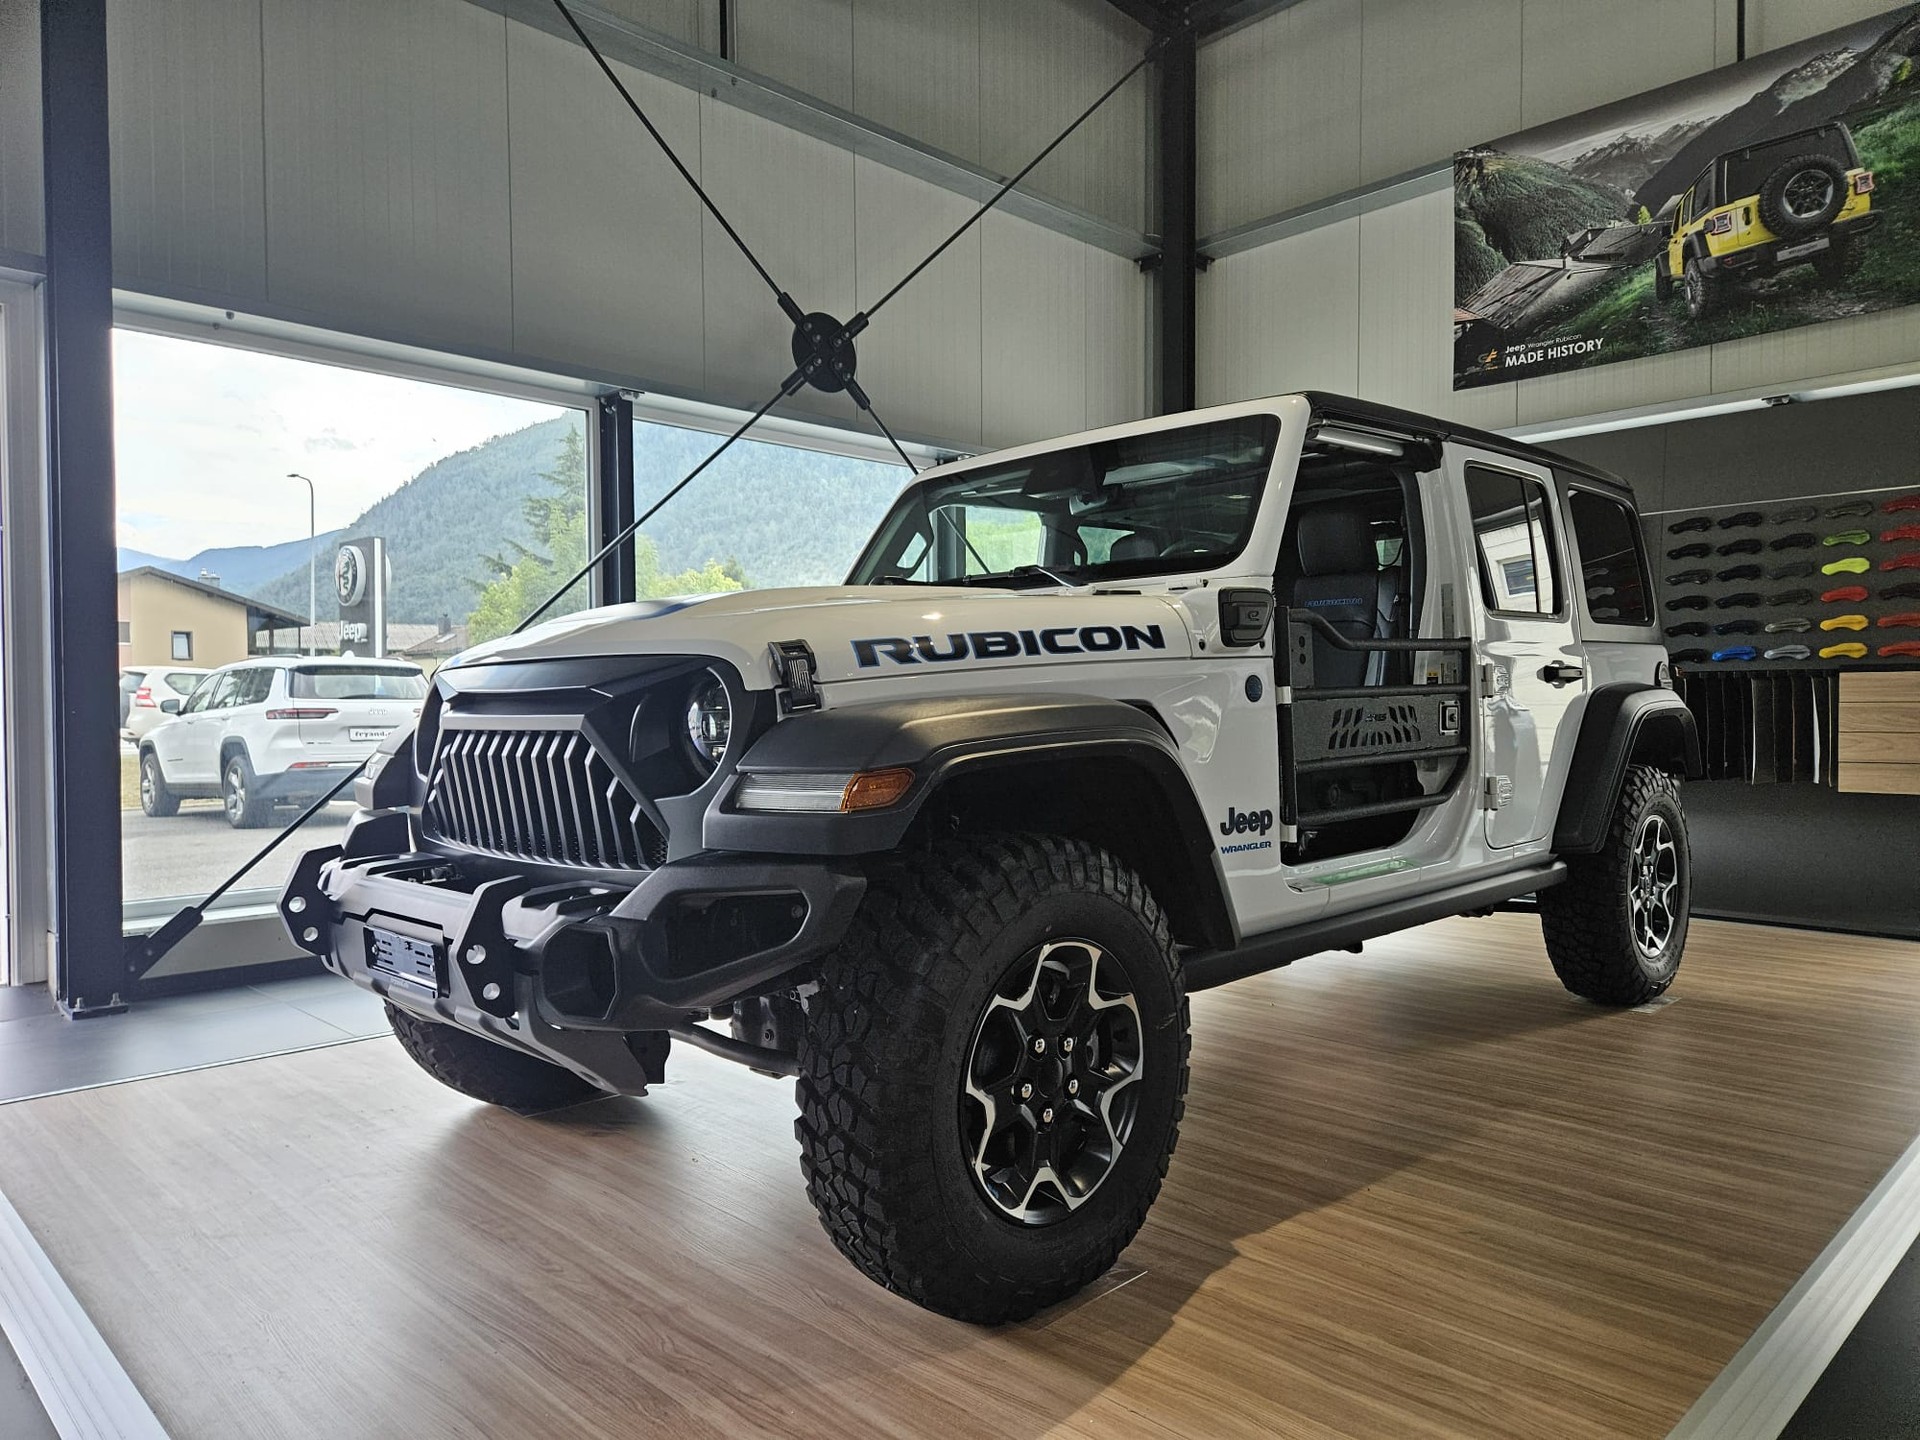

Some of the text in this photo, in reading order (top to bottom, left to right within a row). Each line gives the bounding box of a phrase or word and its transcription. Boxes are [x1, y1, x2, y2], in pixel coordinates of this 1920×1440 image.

[1505, 344, 1526, 354] Jeep
[1555, 333, 1582, 344] Rubicon
[1505, 337, 1604, 368] MADE HISTORY
[339, 620, 367, 643] Jeep
[850, 624, 1166, 668] RUBICON
[1220, 807, 1273, 836] Jeep
[1220, 841, 1272, 854] WRANGLER
